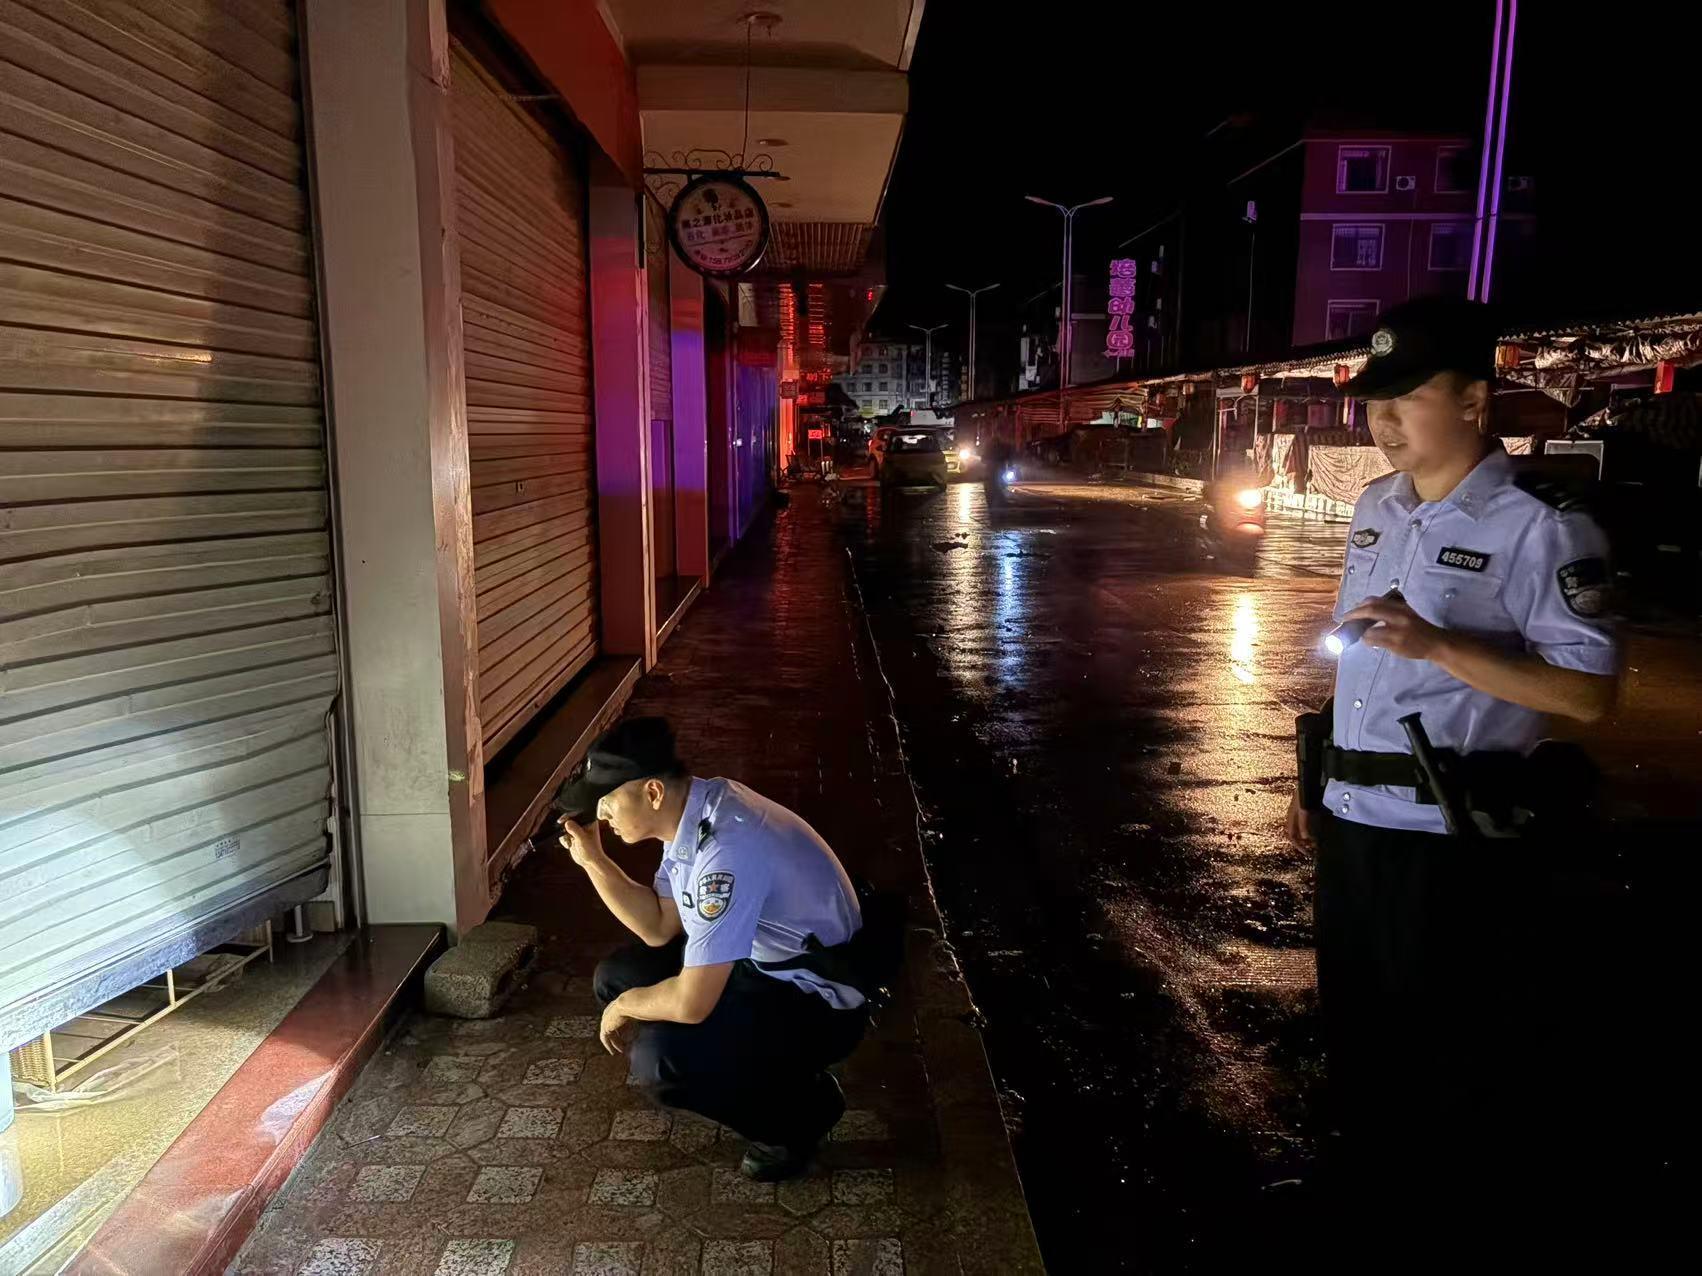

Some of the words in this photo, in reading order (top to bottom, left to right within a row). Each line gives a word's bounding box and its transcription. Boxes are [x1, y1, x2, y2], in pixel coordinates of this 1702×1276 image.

[1106, 258, 1136, 349] 培幼儿园
[1441, 551, 1484, 569] 455709
